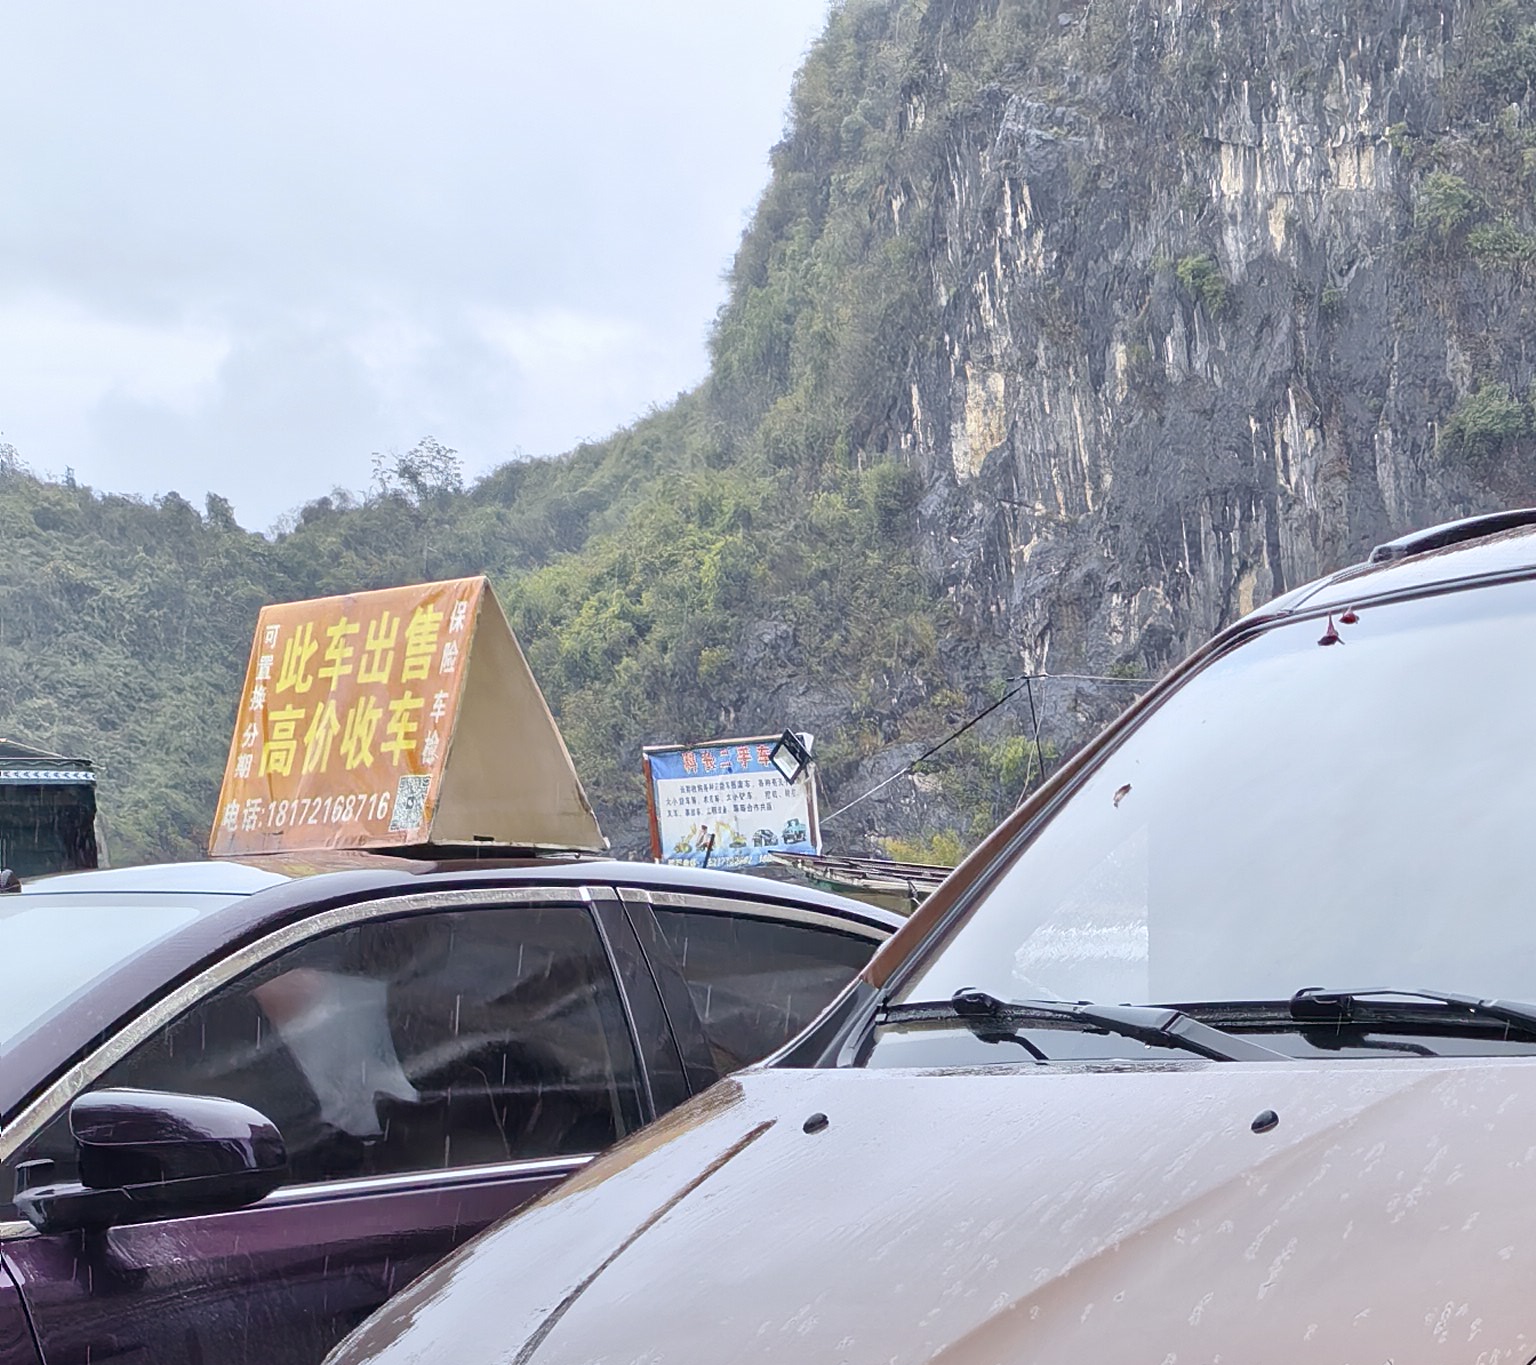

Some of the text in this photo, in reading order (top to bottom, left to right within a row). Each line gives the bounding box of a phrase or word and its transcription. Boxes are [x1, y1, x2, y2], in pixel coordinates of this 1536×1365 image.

[275, 603, 444, 694] 此车出售
[257, 690, 425, 778] 高价收车
